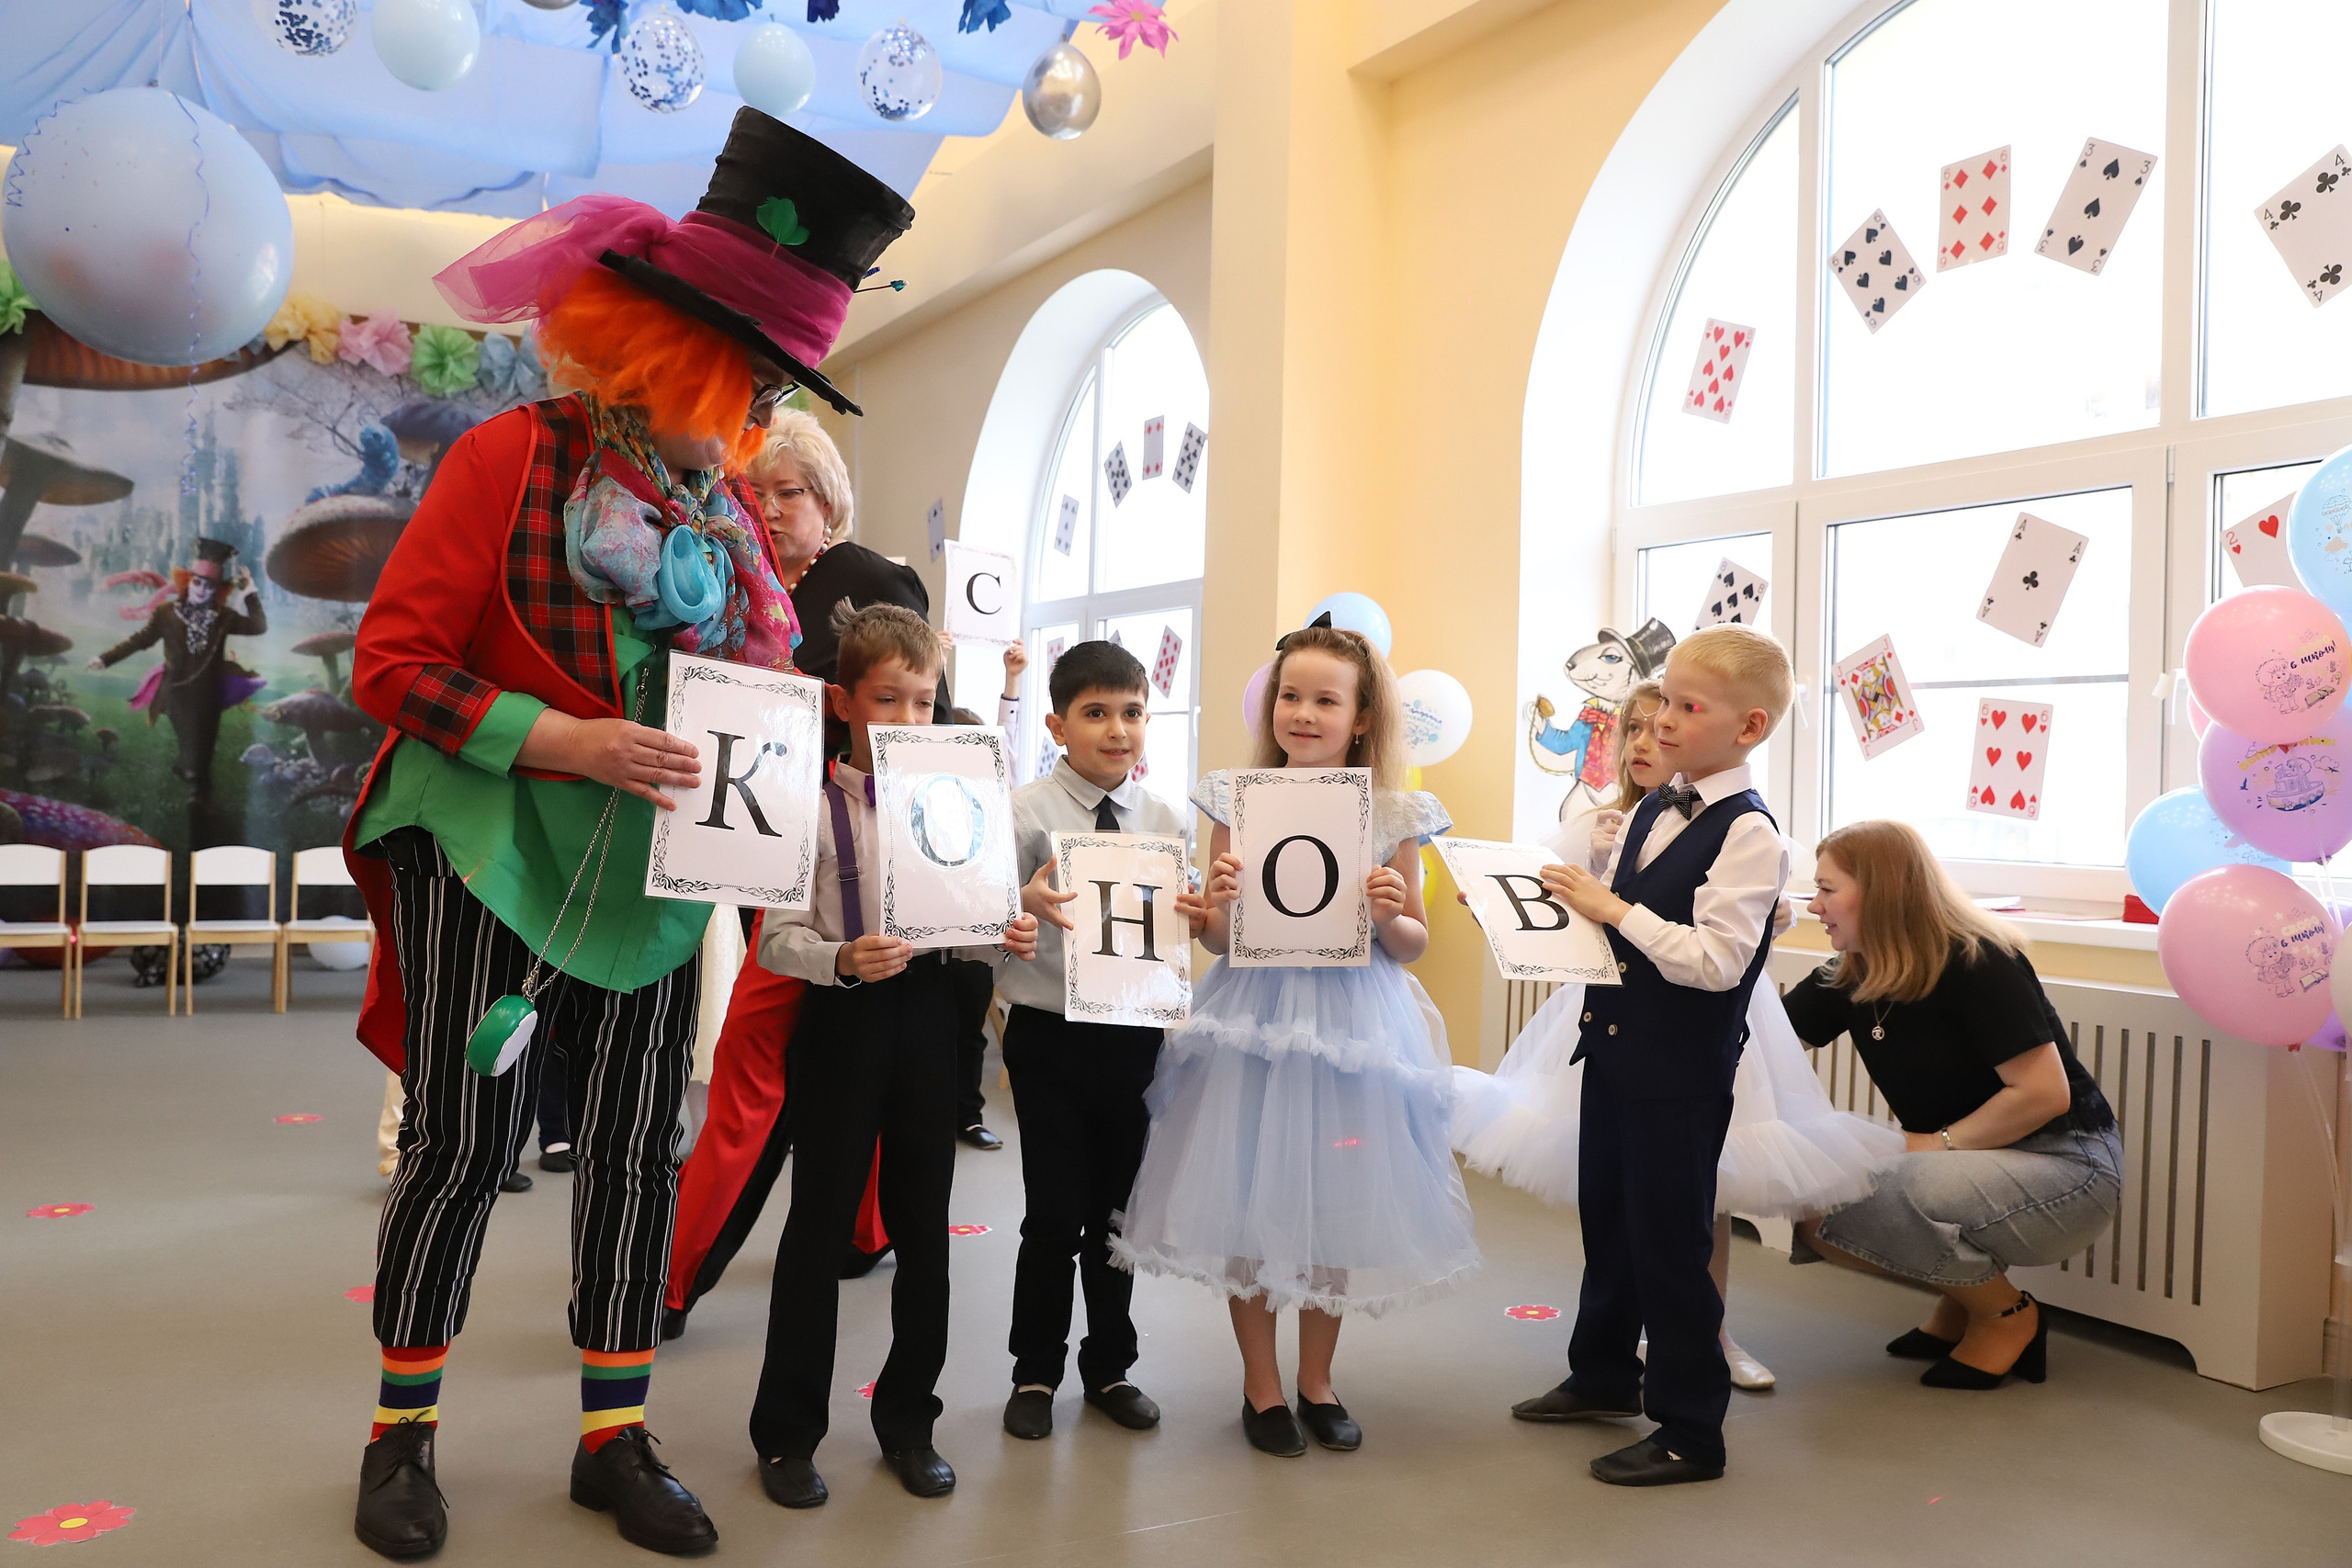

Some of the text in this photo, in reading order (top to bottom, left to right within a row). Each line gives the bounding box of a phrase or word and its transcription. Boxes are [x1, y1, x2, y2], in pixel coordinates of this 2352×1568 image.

[2000, 149, 2007, 163] 6
[2085, 143, 2096, 157] 3
[2335, 153, 2345, 167] 4
[1943, 167, 1951, 181] 6
[2140, 160, 2151, 175] 3
[2264, 208, 2273, 220] 4
[2038, 239, 2048, 254] 3
[2090, 259, 2101, 273] 3
[2312, 290, 2324, 302] 4
[2018, 518, 2027, 532] A
[2225, 531, 2238, 546] 2
[2072, 541, 2081, 555] A
[1721, 560, 1727, 571] 8
[966, 572, 1001, 615] С
[1758, 582, 1765, 594] 8
[1982, 605, 1990, 618] A
[2034, 630, 2043, 643] A
[1883, 638, 1889, 651] J
[2301, 639, 2336, 664] школу!
[1837, 665, 1843, 678] J
[1982, 704, 1989, 716] 6
[2041, 710, 2049, 723] 6
[695, 729, 787, 838] К
[910, 775, 986, 866] О
[1261, 834, 1339, 918] О
[1484, 874, 1570, 931] В
[1088, 880, 1165, 962] Н
[2291, 921, 2326, 942] школу!
